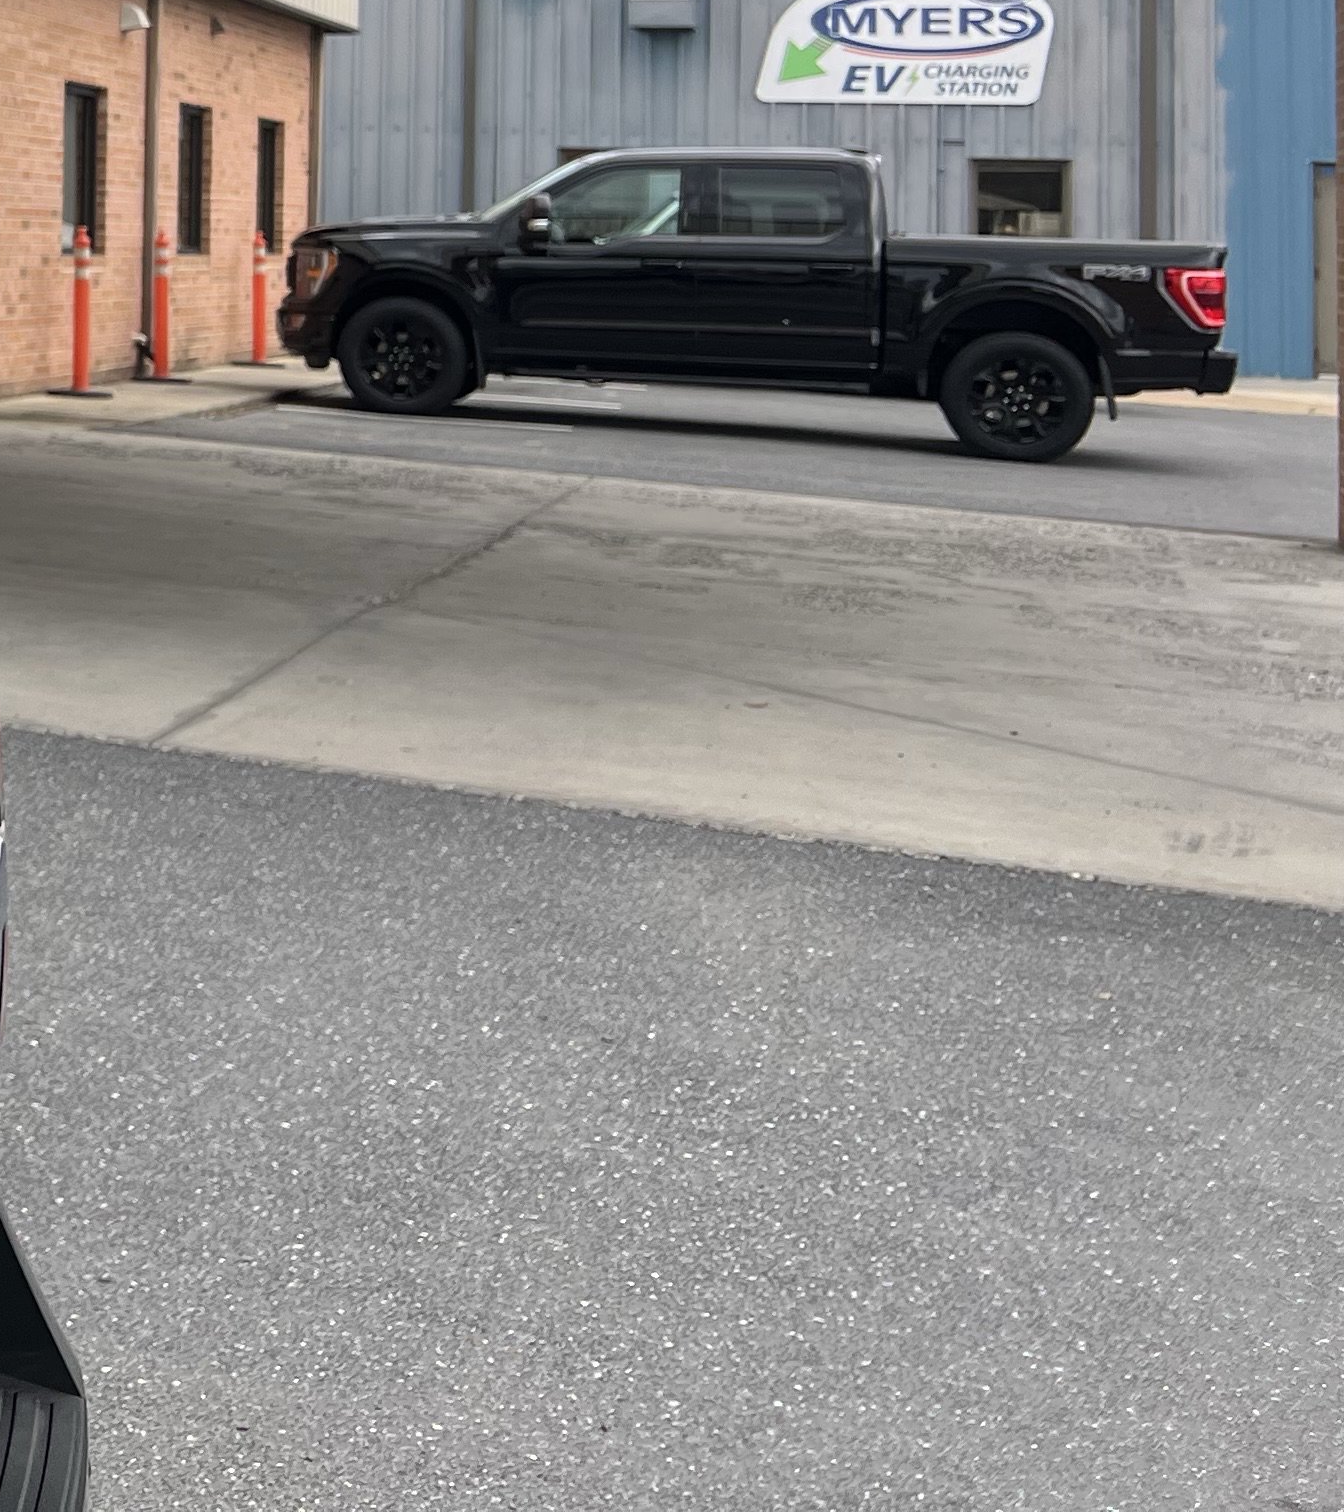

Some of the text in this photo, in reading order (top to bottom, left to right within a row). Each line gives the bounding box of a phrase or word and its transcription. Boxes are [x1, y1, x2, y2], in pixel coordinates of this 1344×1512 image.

[831, 7, 1032, 36] MYERS
[842, 63, 1030, 94] EV CHARGING
[935, 82, 1018, 97] STATION
